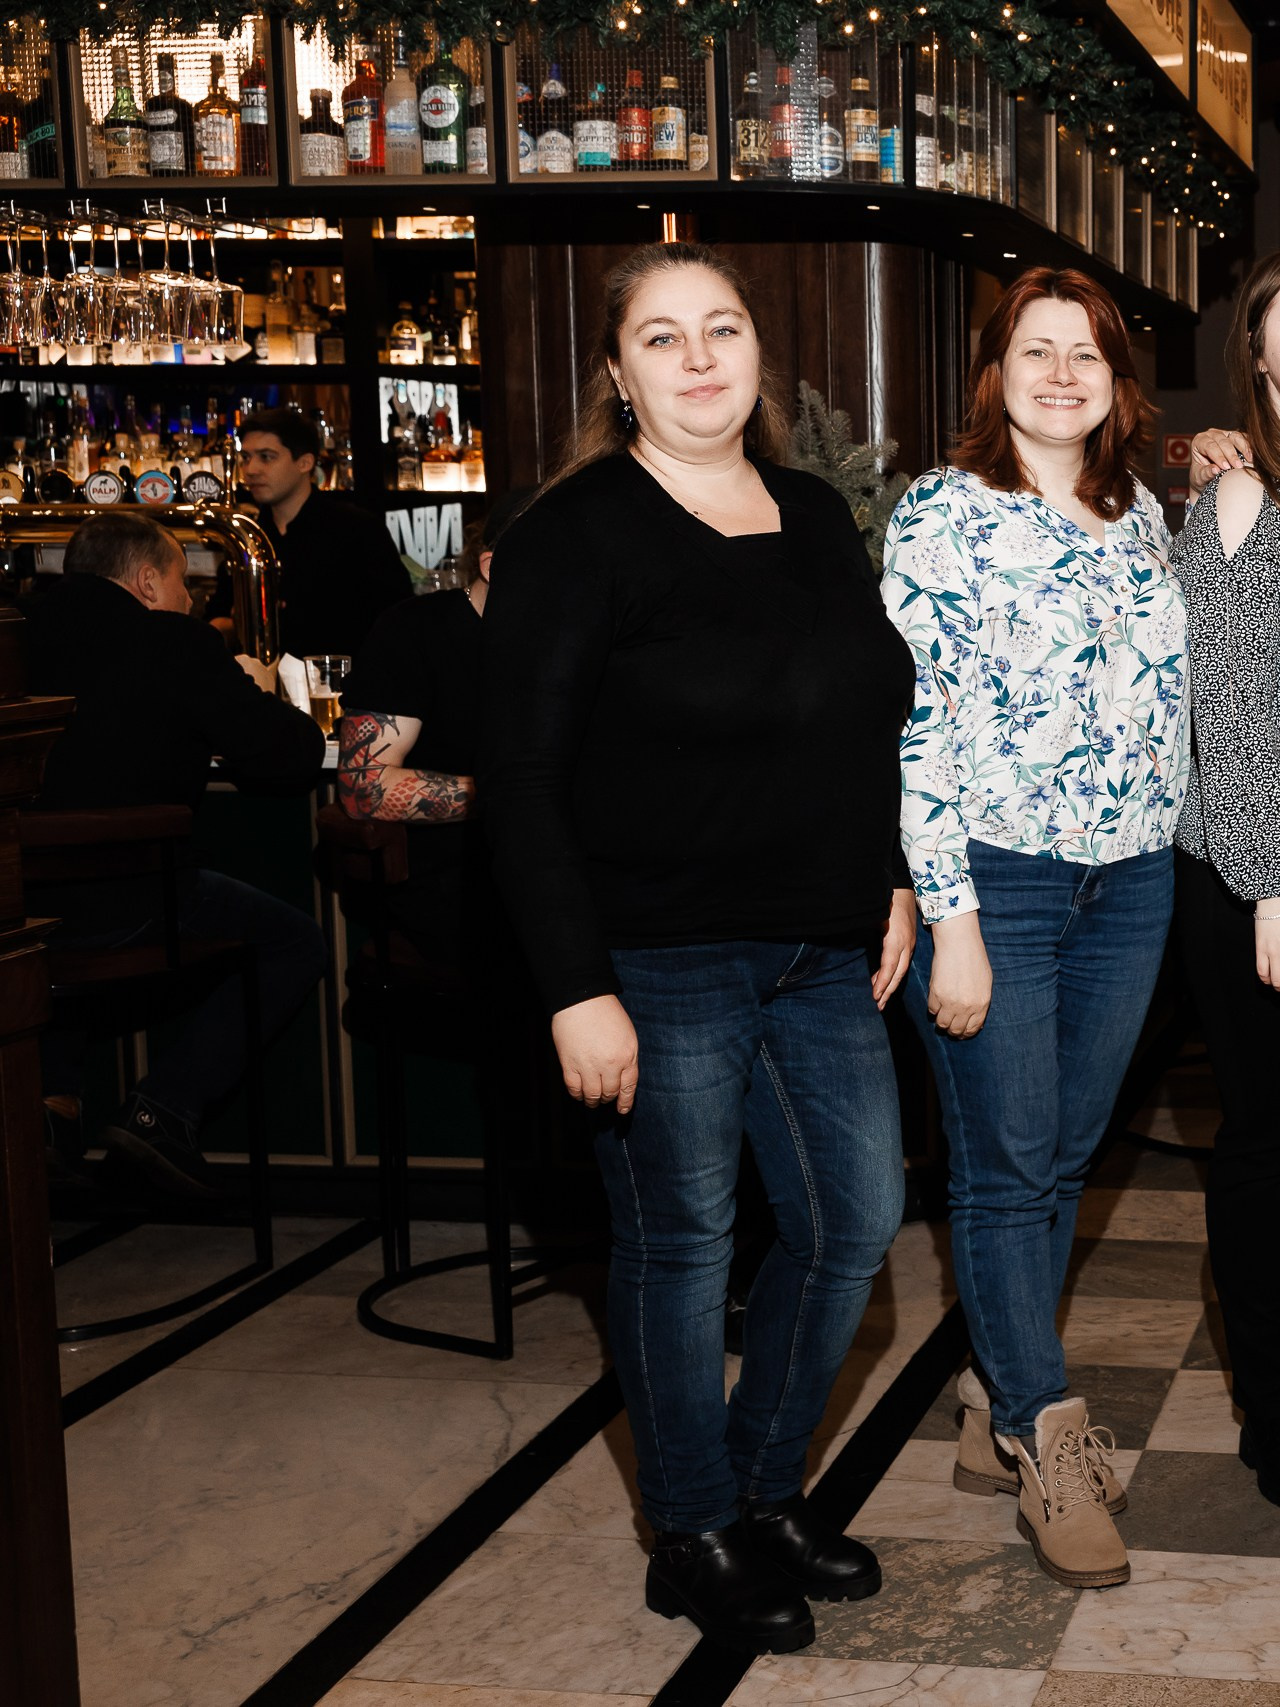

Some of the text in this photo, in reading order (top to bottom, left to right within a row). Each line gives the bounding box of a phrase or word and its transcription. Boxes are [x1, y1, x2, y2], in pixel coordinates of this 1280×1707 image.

[421, 103, 456, 113] MARTINI
[618, 132, 647, 144] PRIDE
[741, 127, 768, 149] 312
